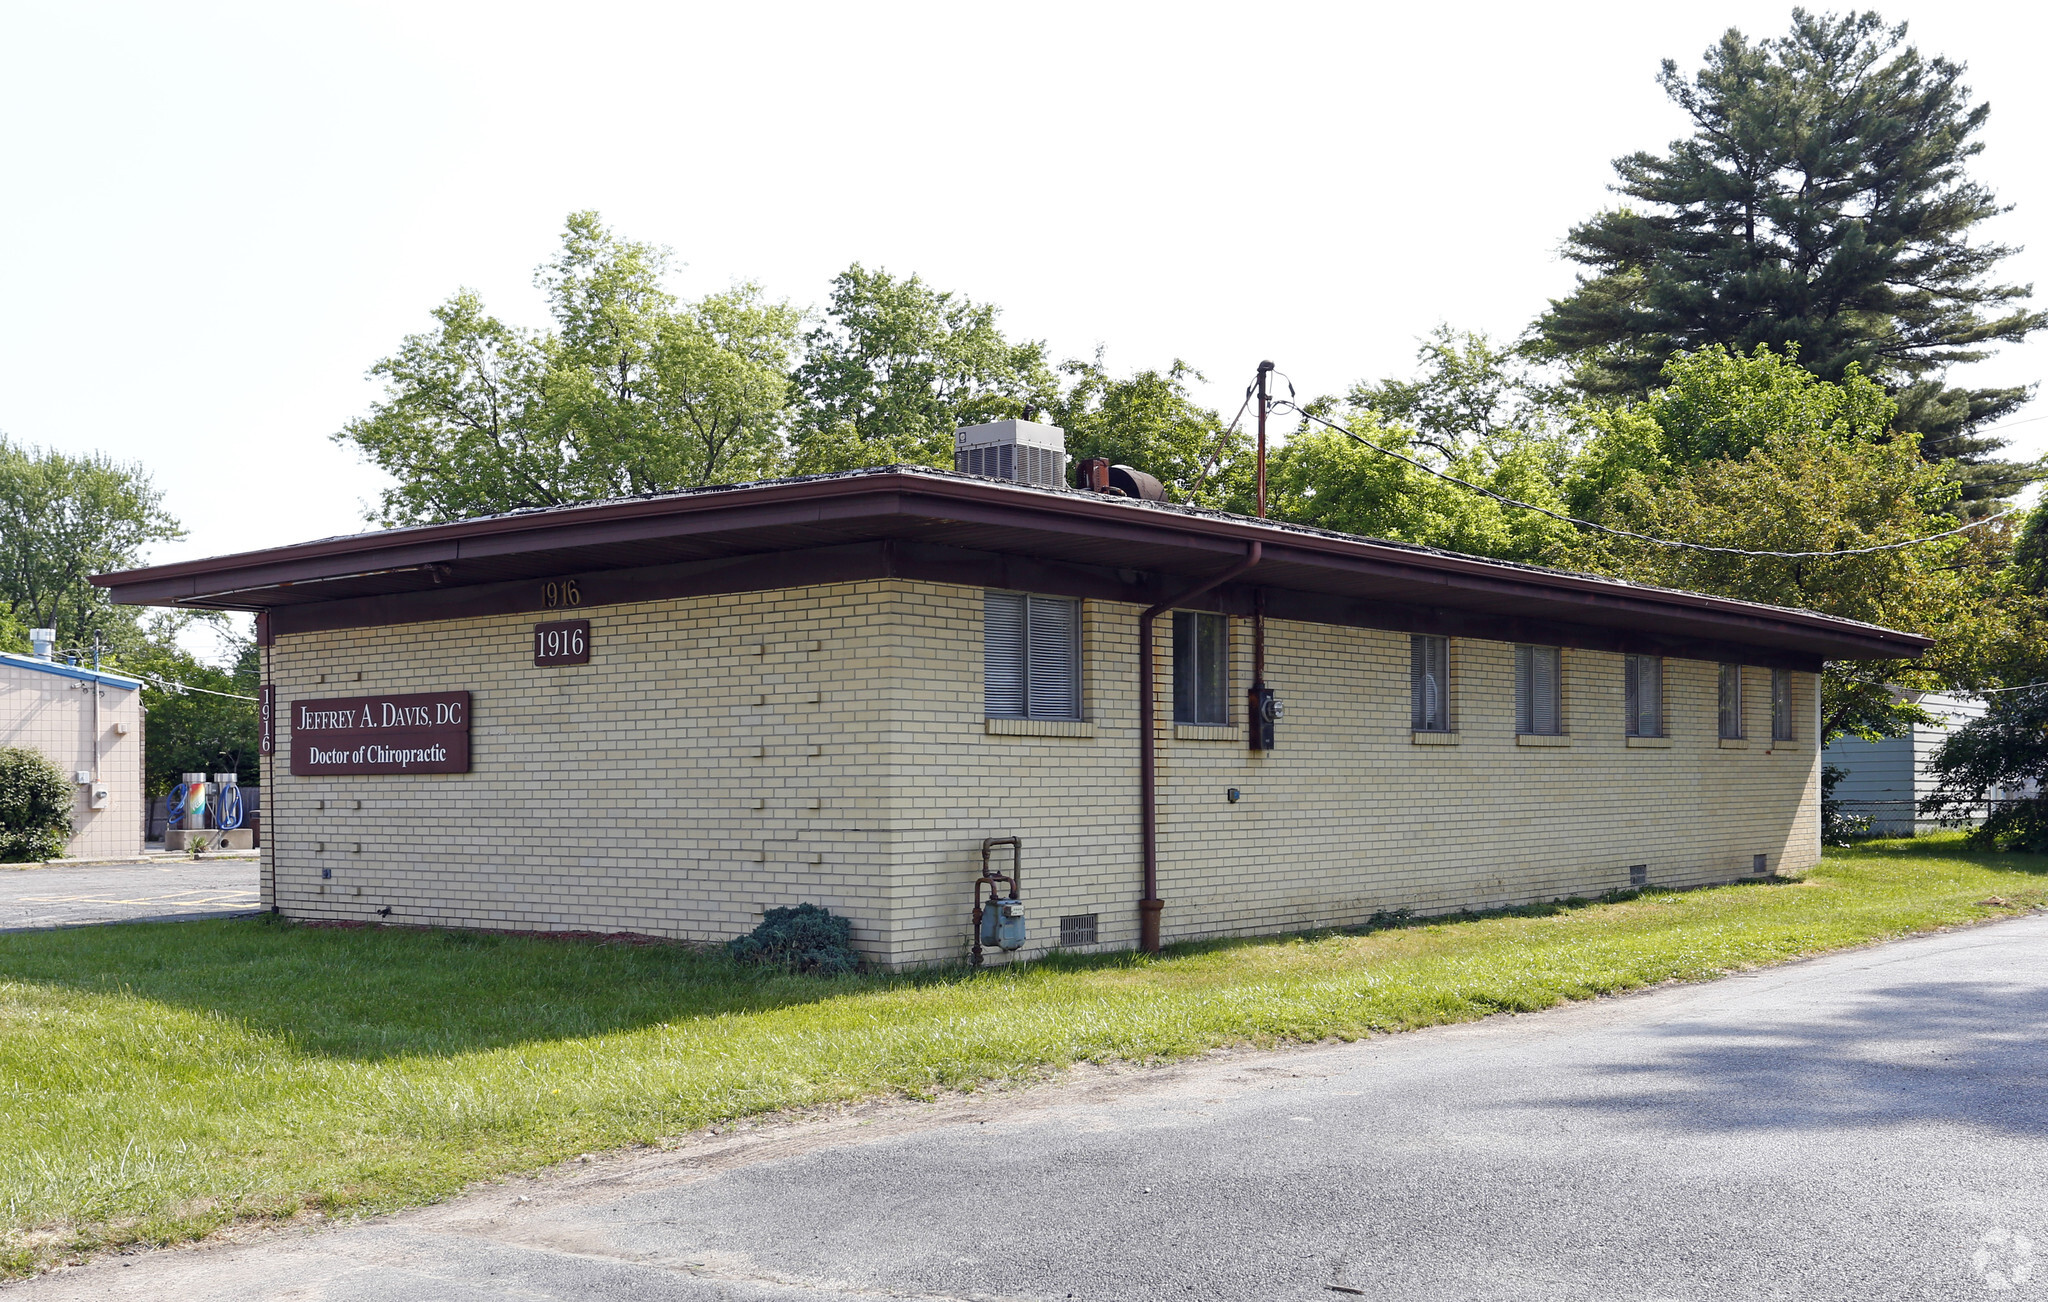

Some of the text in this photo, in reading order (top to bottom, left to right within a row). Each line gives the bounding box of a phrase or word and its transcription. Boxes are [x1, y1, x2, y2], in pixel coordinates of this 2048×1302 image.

[541, 580, 580, 608] 1916
[537, 628, 584, 658] 1916
[262, 688, 270, 752] 1916
[296, 702, 461, 730] JEFFREY A. DAVIS, DC
[309, 743, 447, 768] Doctor of Chiropractic
